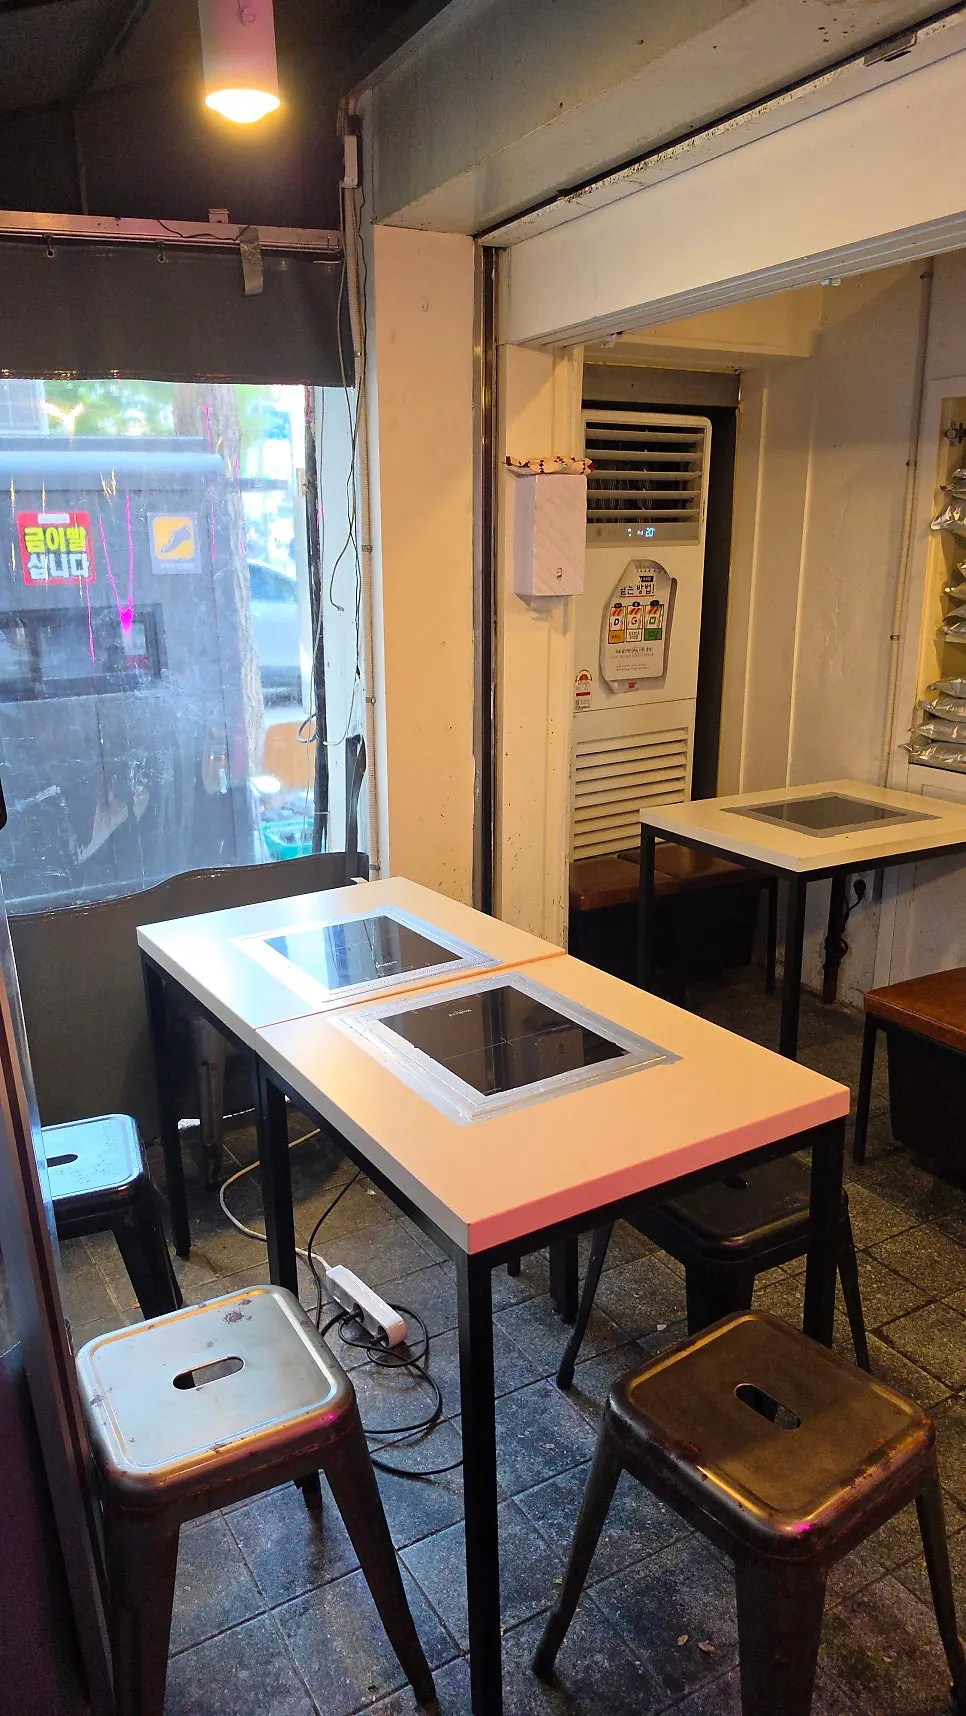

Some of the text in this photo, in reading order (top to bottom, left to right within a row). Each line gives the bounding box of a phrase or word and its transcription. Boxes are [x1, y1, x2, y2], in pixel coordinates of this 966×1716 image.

[24, 526, 87, 553] 금이빨
[27, 552, 90, 579] 삽니다
[636, 583, 655, 595] 방법!
